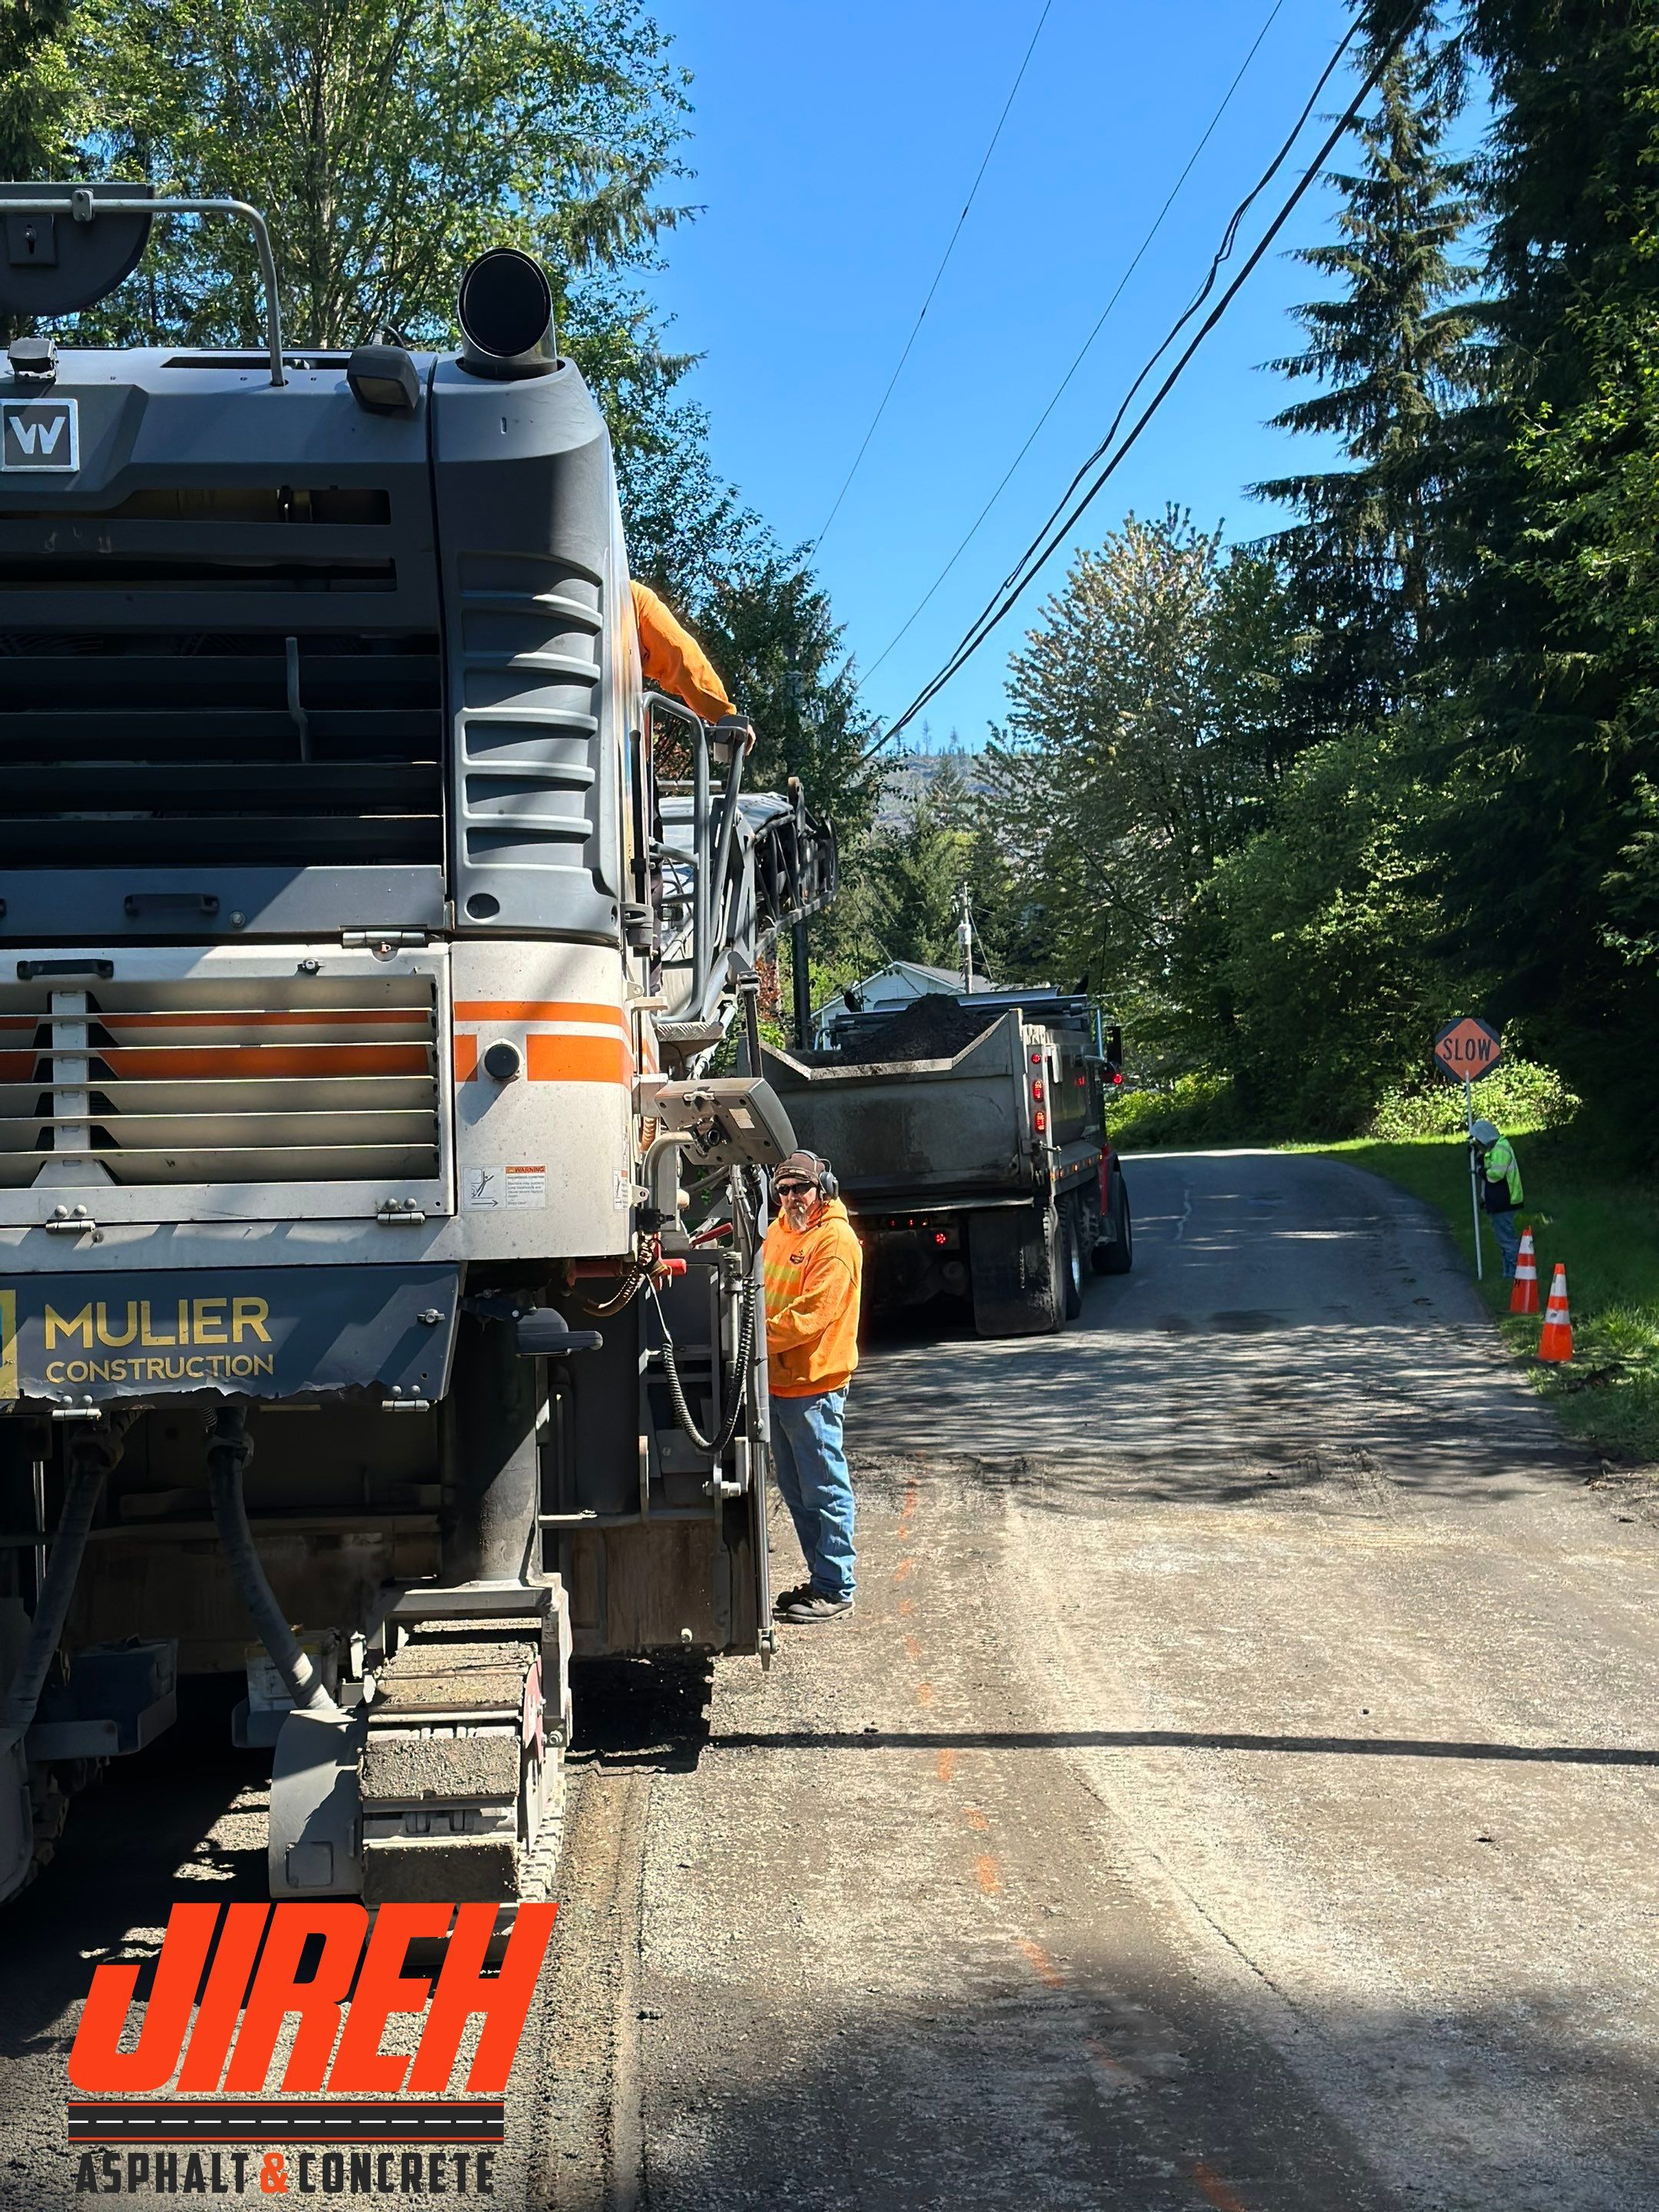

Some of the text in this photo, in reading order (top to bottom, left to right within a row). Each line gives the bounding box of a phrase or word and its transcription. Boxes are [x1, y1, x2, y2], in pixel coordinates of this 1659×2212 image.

[1442, 1038, 1492, 1061] SLOW
[45, 1296, 273, 1349] MULIER
[45, 1354, 274, 1384] CONSTRUCTION
